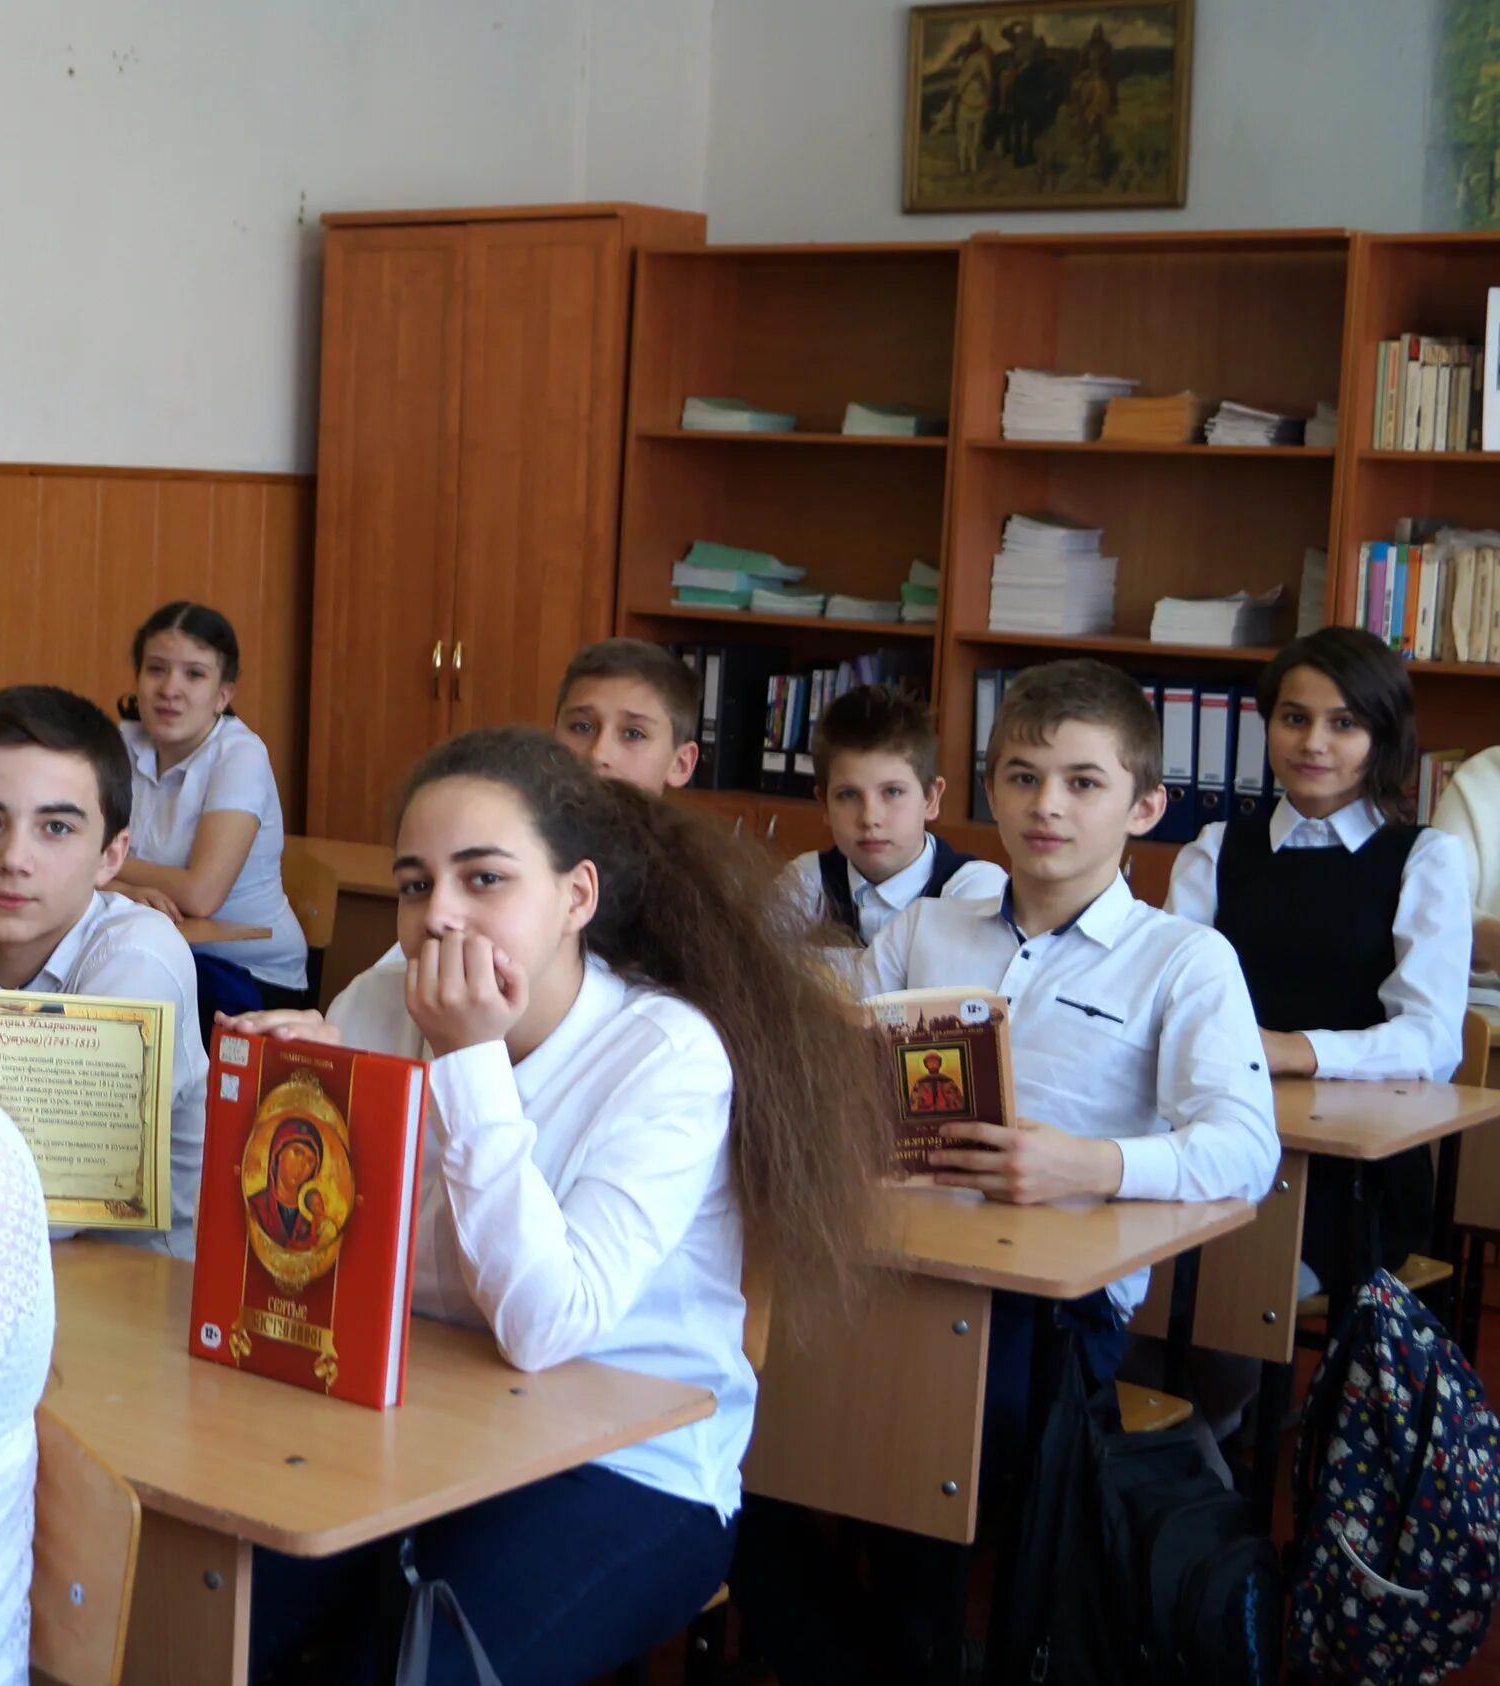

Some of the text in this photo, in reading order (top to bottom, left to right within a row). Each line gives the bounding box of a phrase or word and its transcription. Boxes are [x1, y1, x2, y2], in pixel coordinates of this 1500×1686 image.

[966, 1003, 983, 1014] 12+
[28, 1018, 97, 1037] Илларионович
[205, 1327, 219, 1341] 12+
